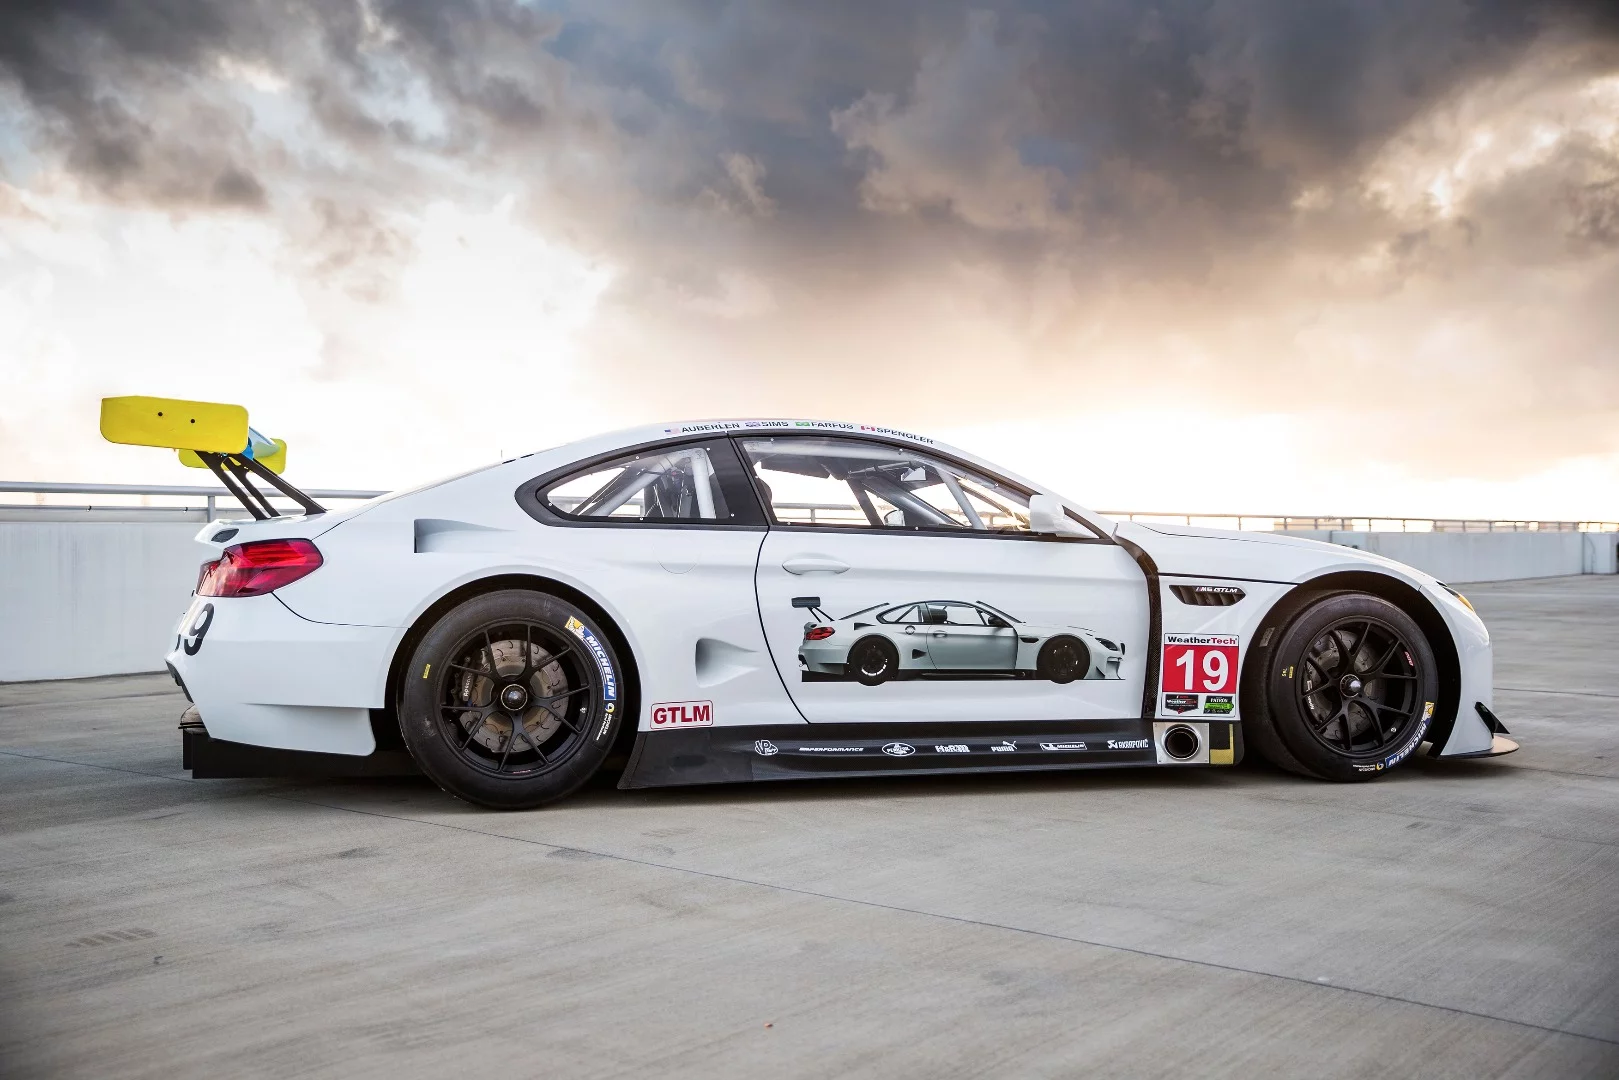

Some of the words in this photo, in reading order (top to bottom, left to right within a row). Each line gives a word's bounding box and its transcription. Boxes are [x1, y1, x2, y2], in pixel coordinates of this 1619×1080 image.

[681, 422, 740, 433] AUBERLEN
[811, 421, 854, 430] FARFUS
[876, 427, 934, 445] SPENGLER
[1168, 636, 1236, 645] WeatherTech
[586, 636, 615, 698] MICHELIN
[1176, 649, 1229, 692] 19
[653, 705, 710, 725] GTLM
[1388, 722, 1427, 767] MICHELIN
